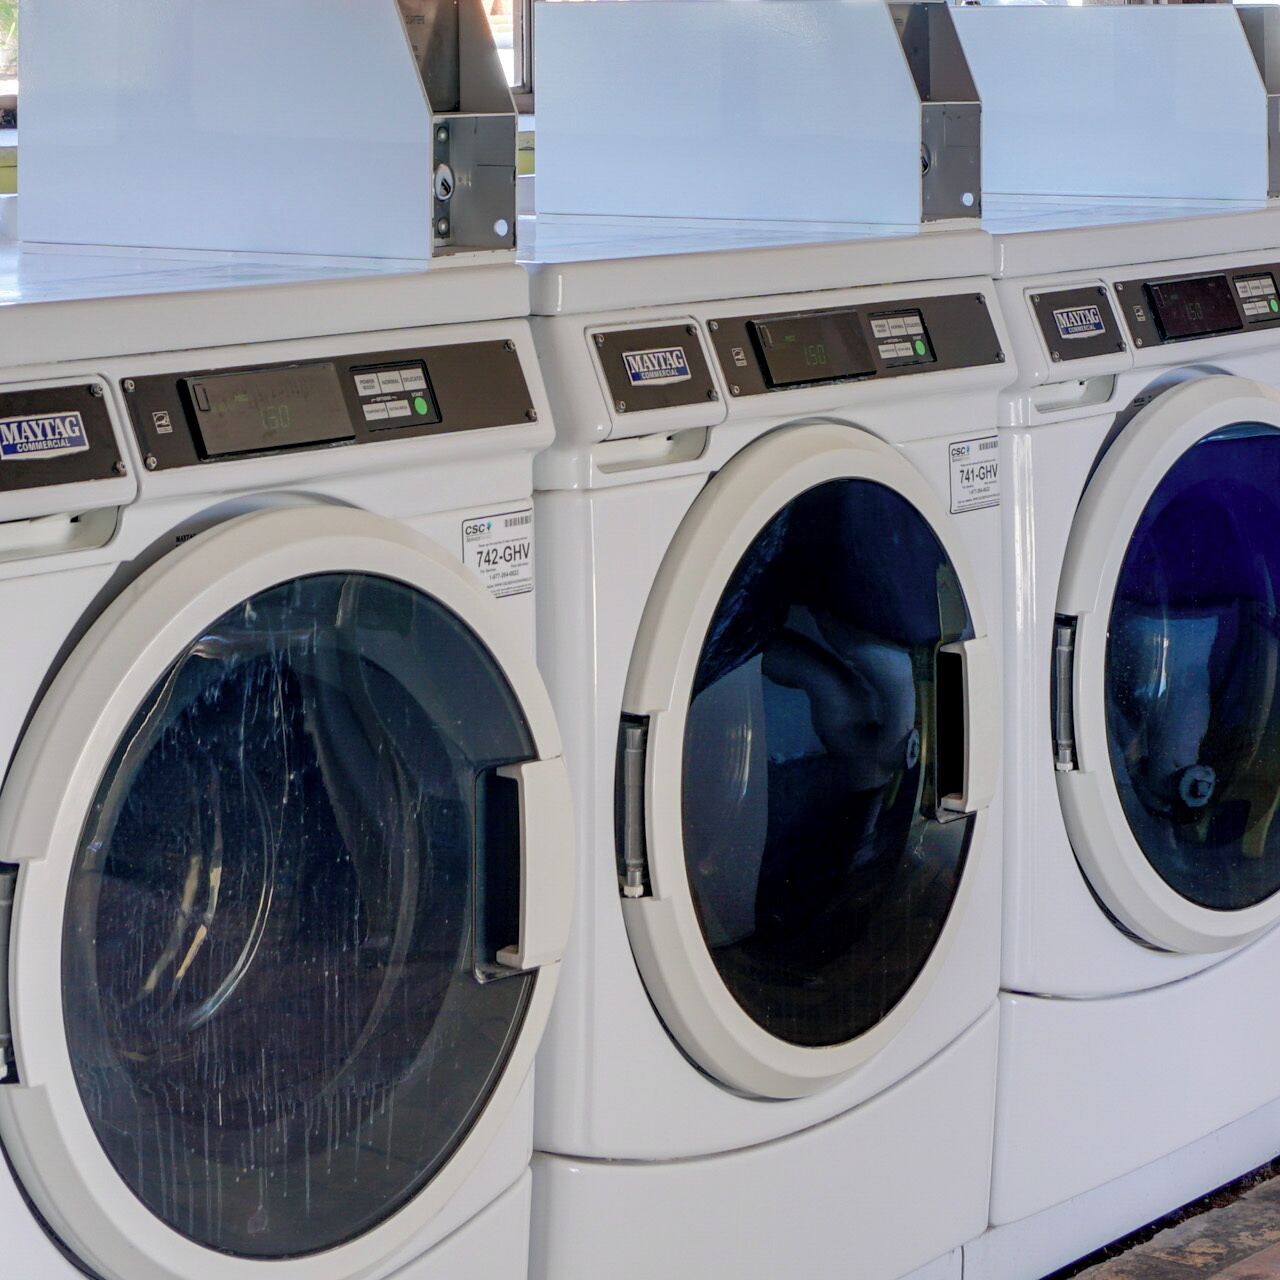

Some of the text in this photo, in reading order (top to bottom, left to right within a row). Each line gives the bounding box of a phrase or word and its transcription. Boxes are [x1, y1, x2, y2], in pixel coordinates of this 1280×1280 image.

[1056, 309, 1100, 328] MAYTAG
[627, 351, 685, 373] MAYTAG
[641, 368, 678, 379] COMMERCIAL
[16, 439, 71, 452] COMMERCIAL
[951, 447, 966, 457] CSC
[960, 464, 998, 484] 741-GHV
[465, 523, 486, 535] CSC
[477, 542, 531, 568] 742-GHV
